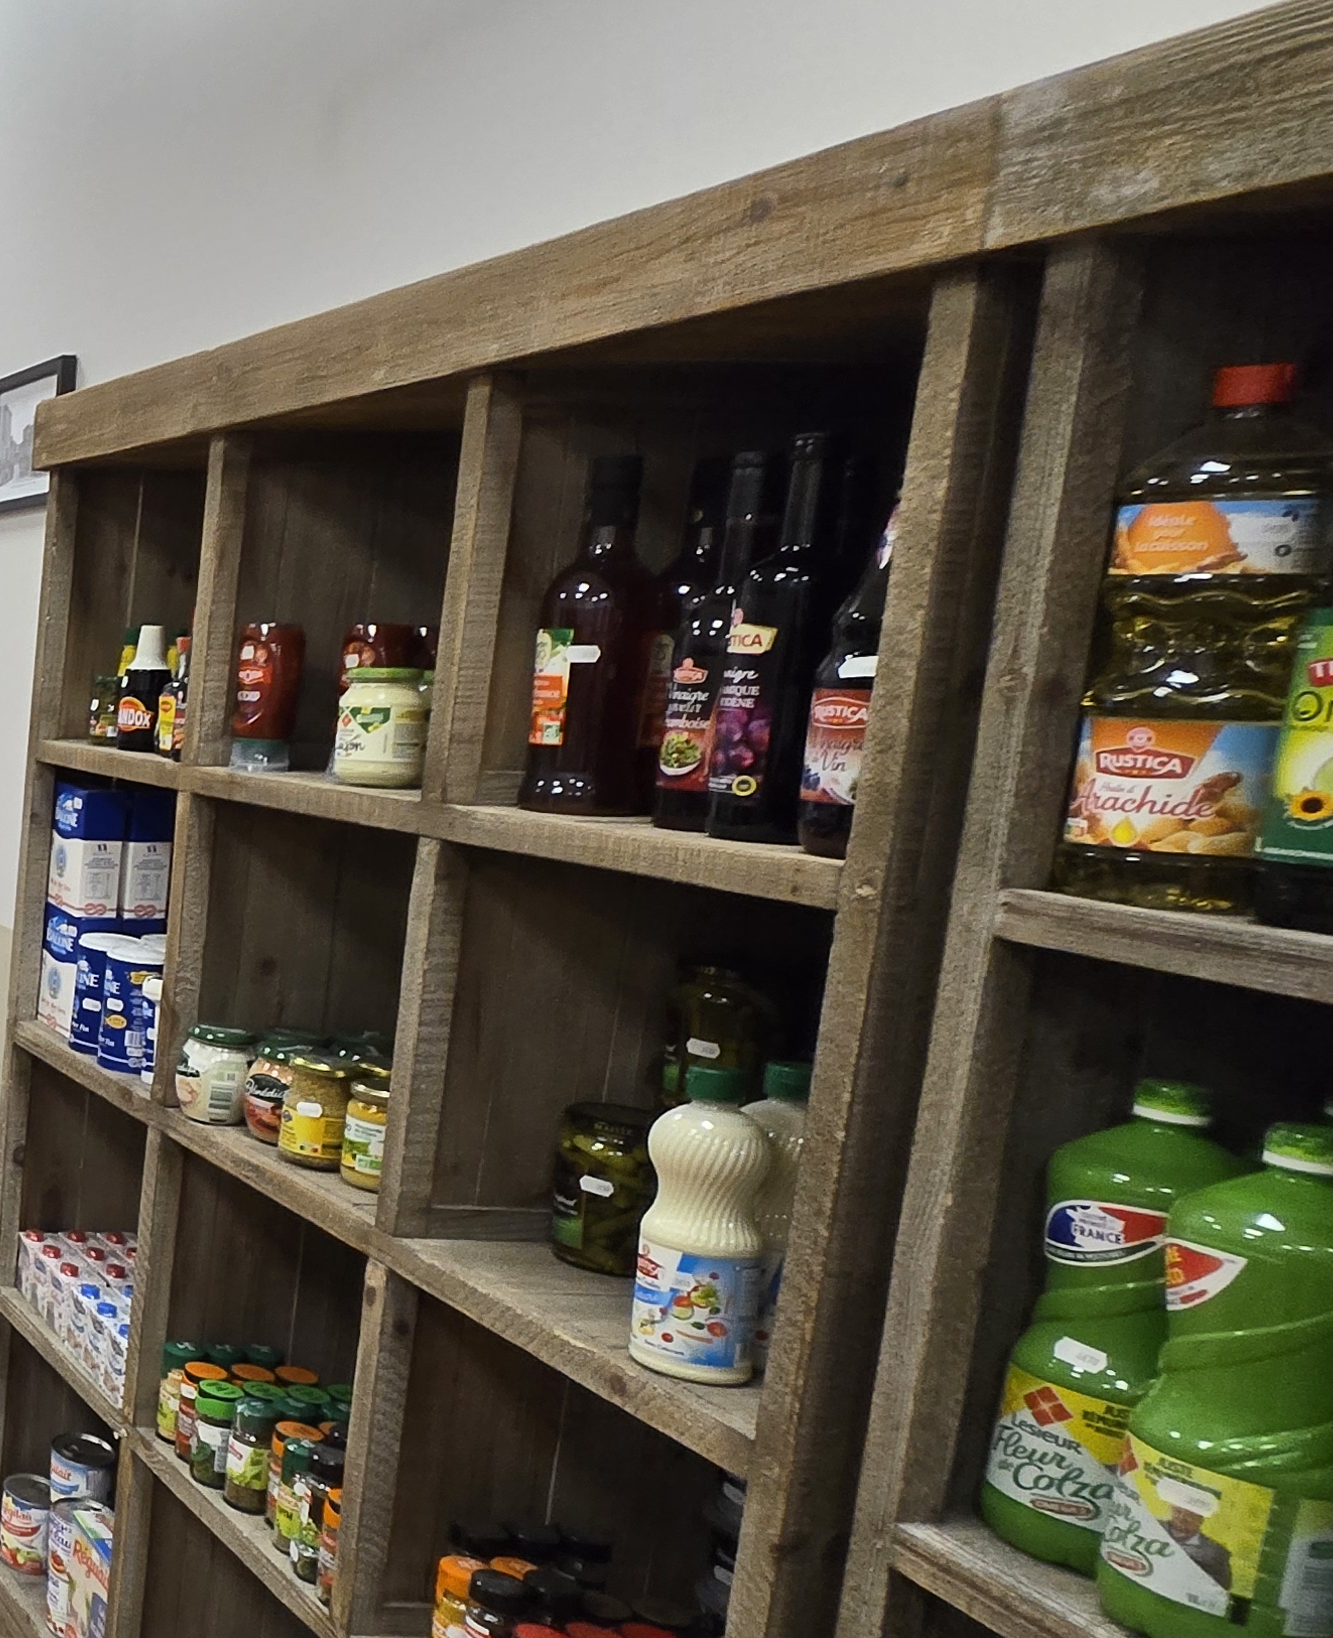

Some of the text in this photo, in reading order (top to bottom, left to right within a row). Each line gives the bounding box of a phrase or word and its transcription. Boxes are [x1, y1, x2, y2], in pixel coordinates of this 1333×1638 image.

[728, 633, 763, 648] TICA
[117, 708, 153, 728] ANDOX
[812, 704, 869, 723] RUSTICA
[1099, 752, 1183, 774] RUSTICA
[1071, 777, 1217, 820] Arachide
[1073, 1222, 1123, 1246] FRANCE
[1012, 1461, 1115, 1506] Colza
[1103, 1520, 1176, 1560] olza
